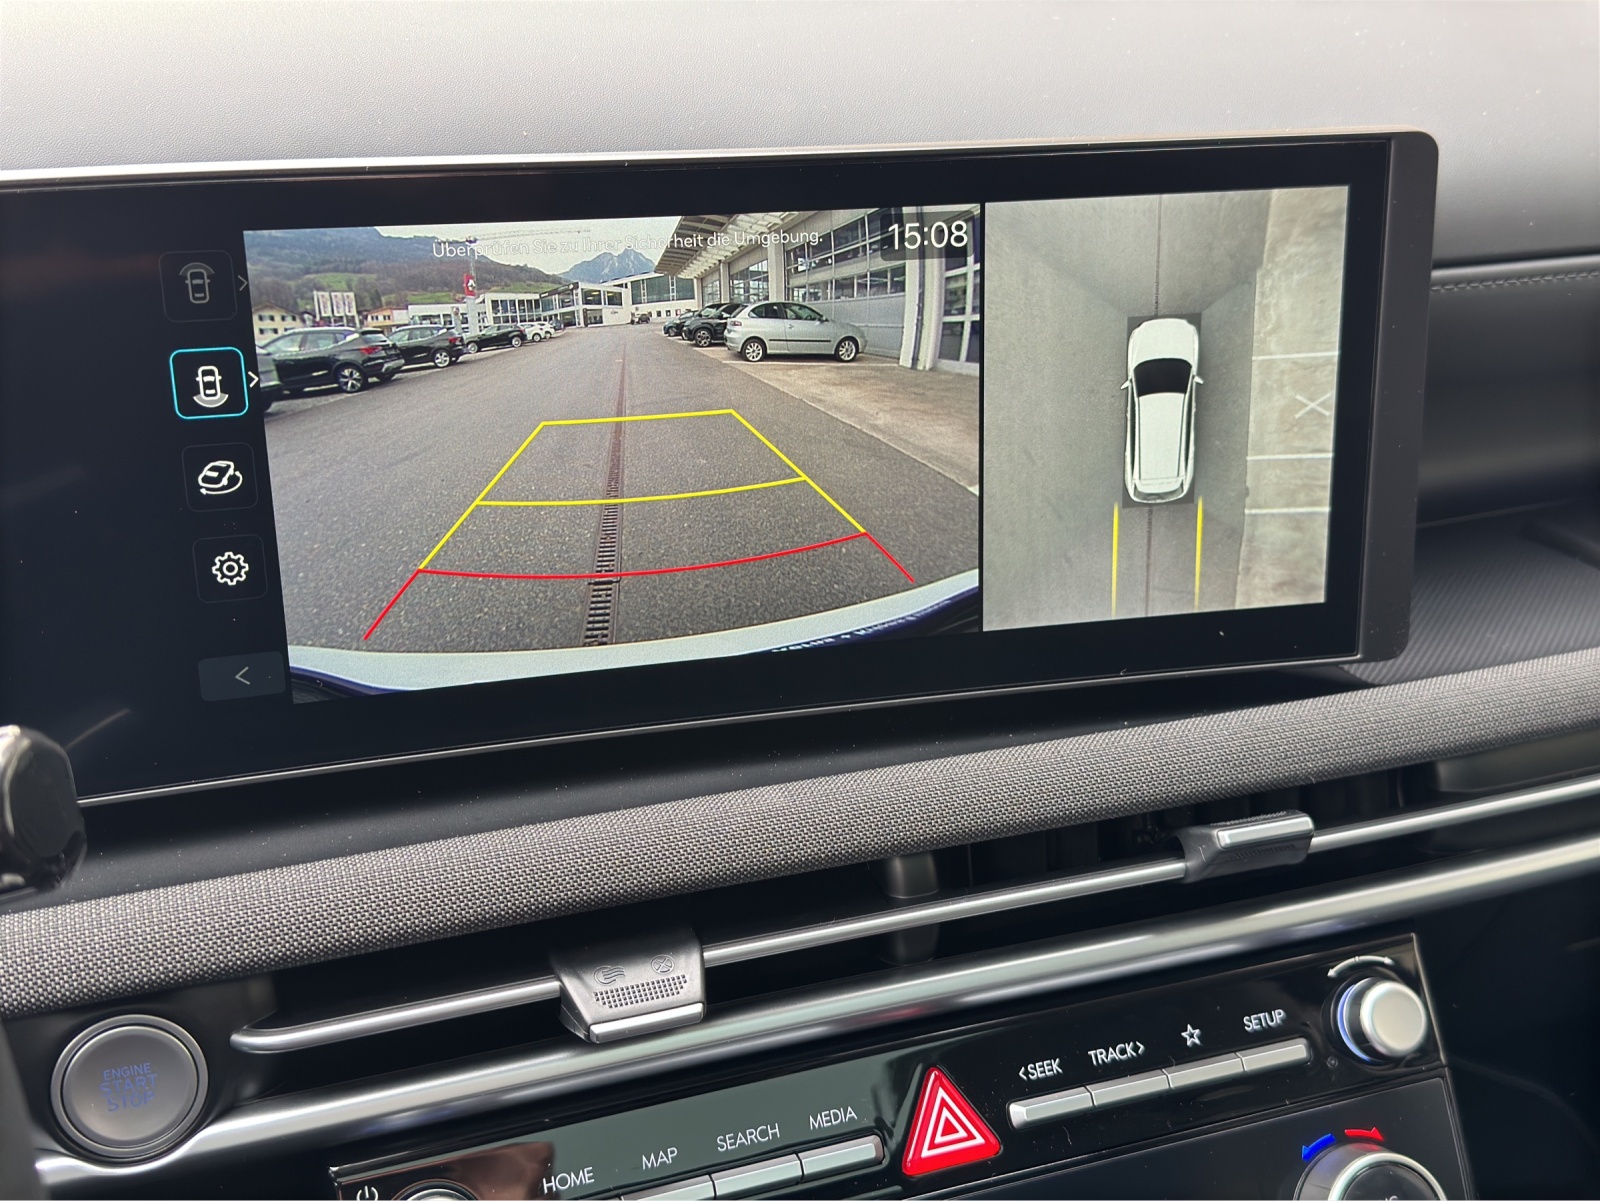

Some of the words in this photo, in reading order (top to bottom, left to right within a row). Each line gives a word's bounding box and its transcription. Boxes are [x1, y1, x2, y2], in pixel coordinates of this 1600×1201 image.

[432, 238, 529, 259] Überprüfen
[533, 239, 552, 254] Sie
[560, 242, 578, 253] zu
[582, 237, 622, 253] Ihrer
[625, 233, 703, 250] Sicherheit
[707, 231, 730, 247] die
[734, 229, 823, 249] Umgebung.
[888, 220, 968, 251] 15:08
[1243, 1008, 1286, 1032] SETUP
[103, 1062, 151, 1080] ENGINE
[100, 1073, 158, 1097] START
[107, 1090, 155, 1112] STOP
[809, 1105, 858, 1131] MEDIA
[716, 1123, 781, 1151] SEARCH
[641, 1147, 678, 1170] MAP
[542, 1166, 595, 1195] HOME
